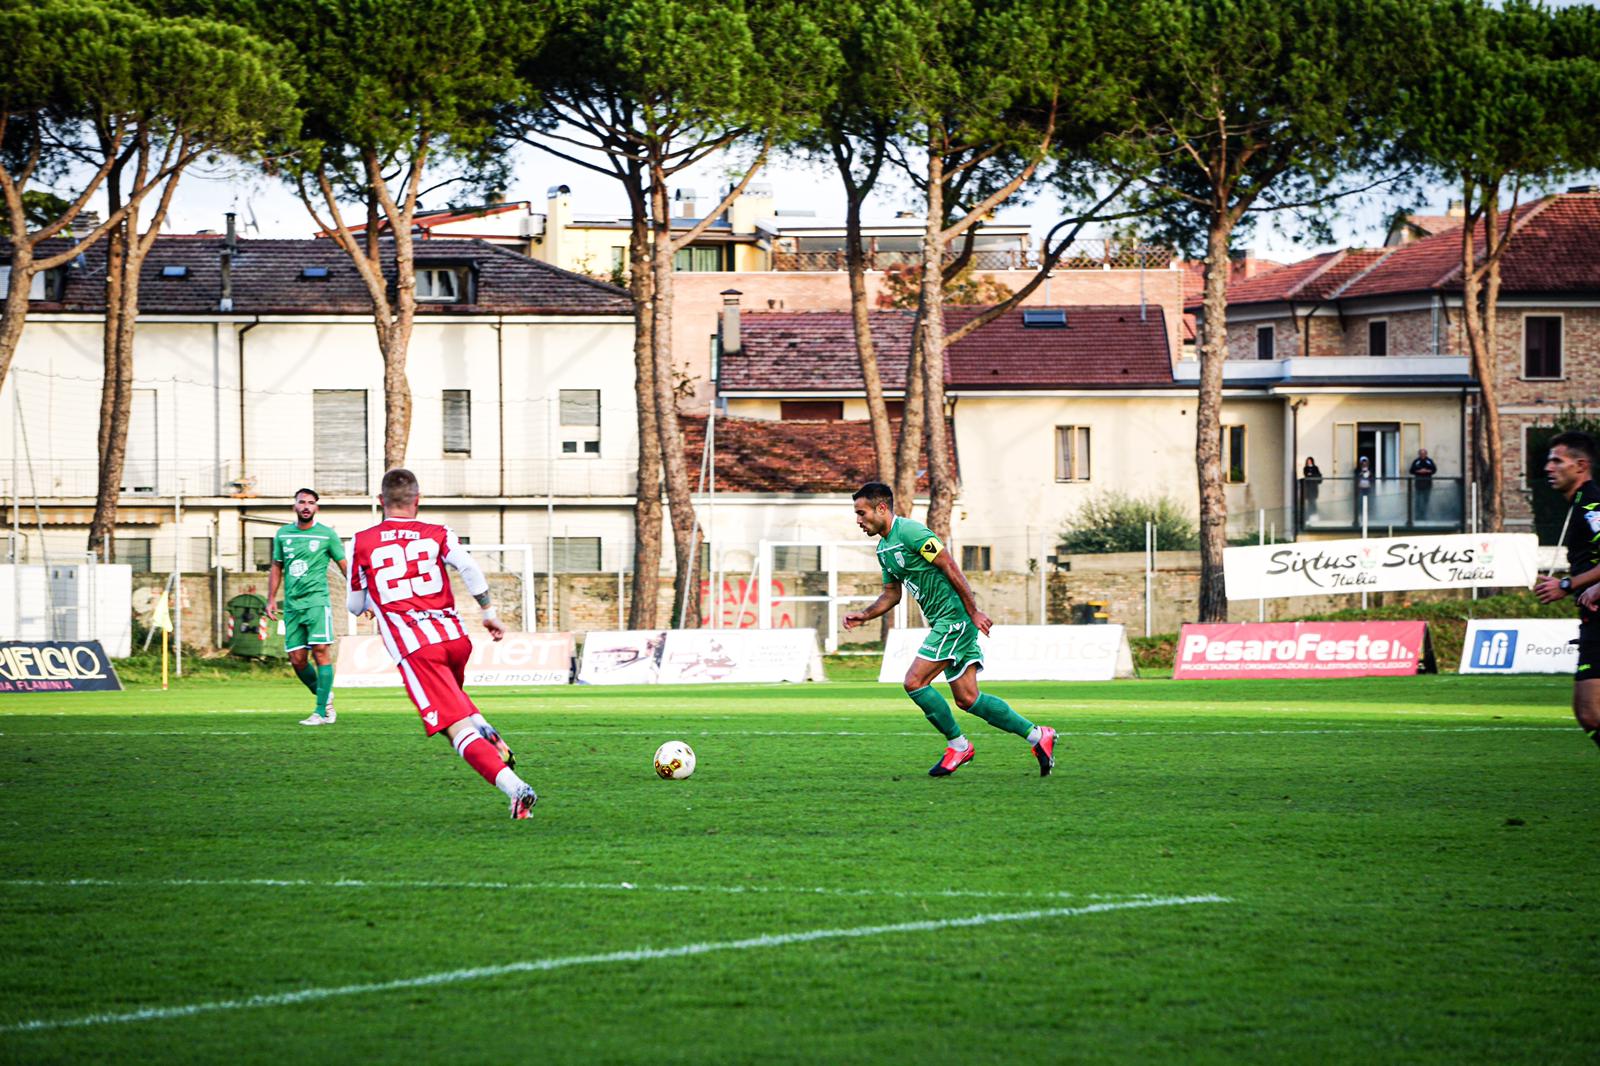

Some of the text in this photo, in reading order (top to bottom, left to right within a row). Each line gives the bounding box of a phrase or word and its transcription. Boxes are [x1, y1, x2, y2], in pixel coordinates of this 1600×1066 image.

[371, 538, 444, 605] 23
[1266, 543, 1475, 587] Sixtus Sixtus
[1448, 566, 1494, 582] Italia
[1182, 633, 1390, 662] PesaroFeste
[1526, 642, 1576, 657] People
[16, 681, 74, 690] FLAMINIA
[473, 673, 562, 683] del mobile
